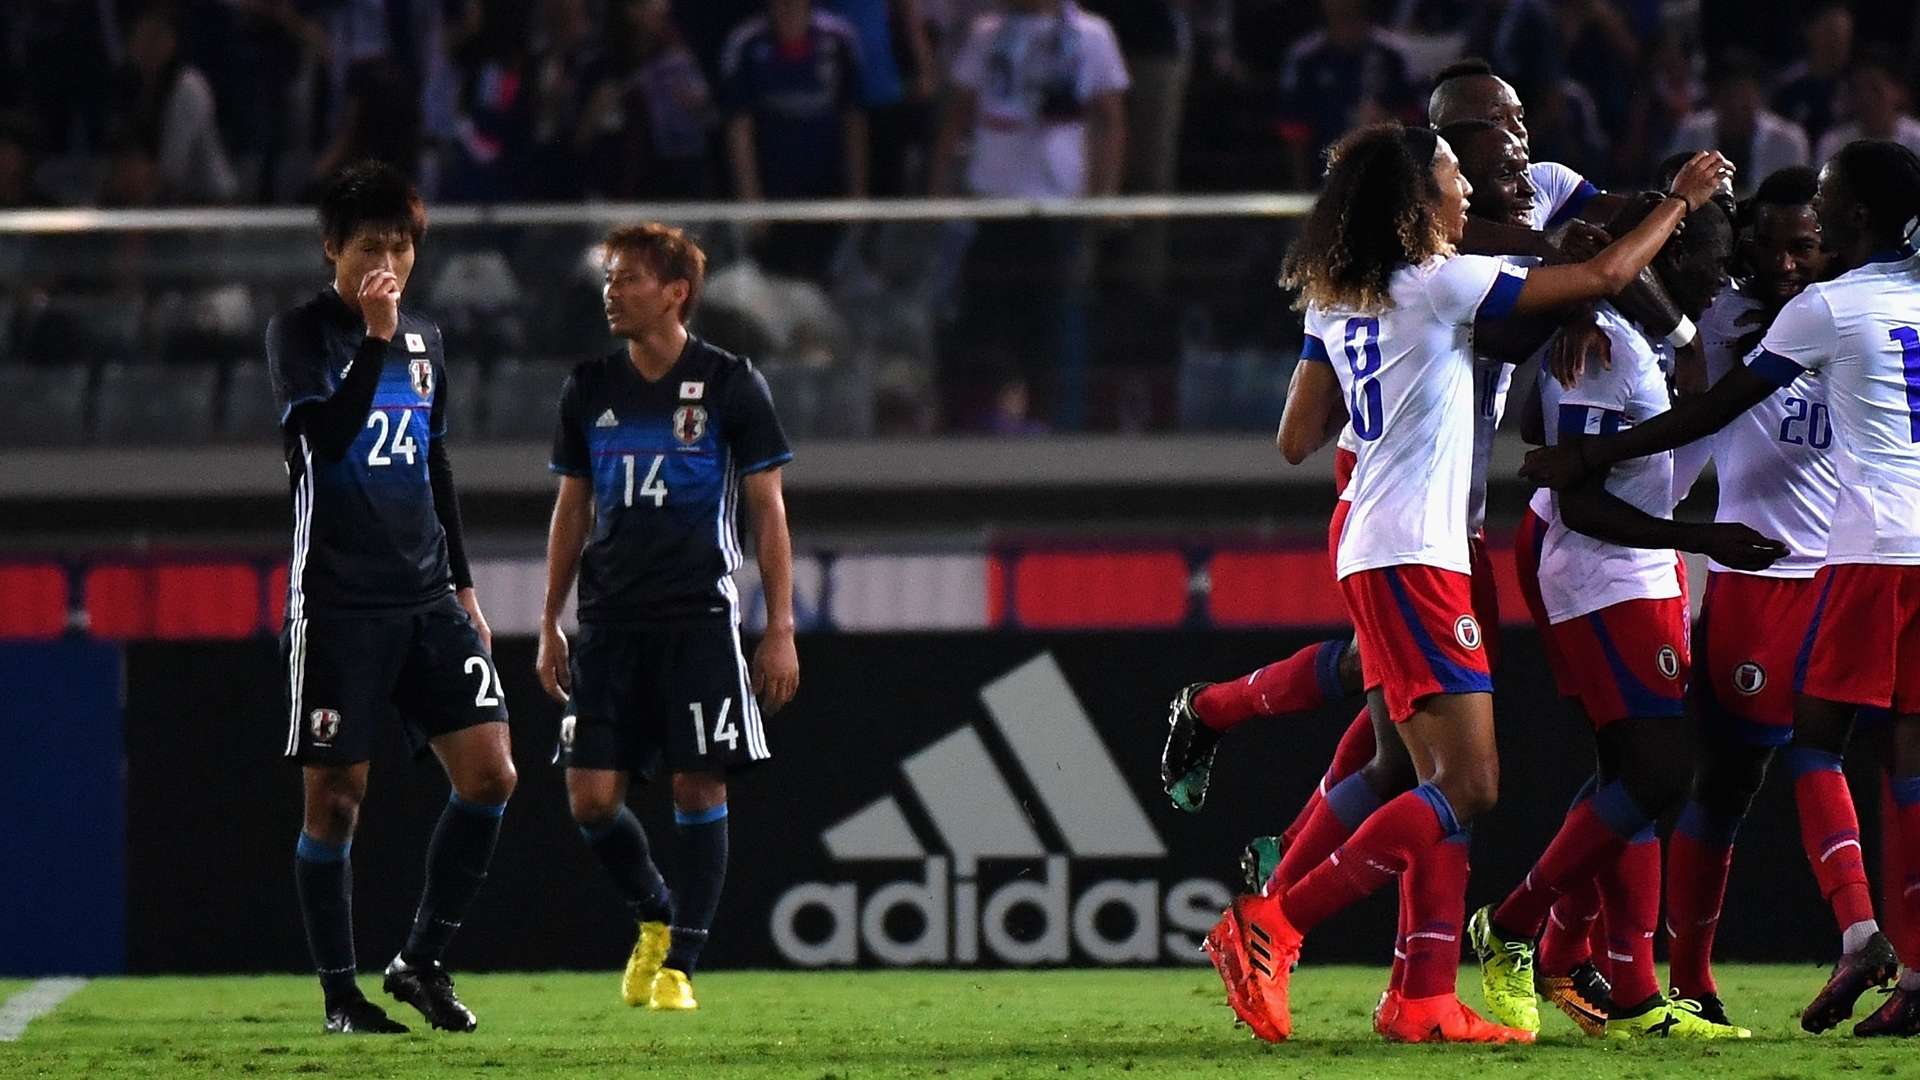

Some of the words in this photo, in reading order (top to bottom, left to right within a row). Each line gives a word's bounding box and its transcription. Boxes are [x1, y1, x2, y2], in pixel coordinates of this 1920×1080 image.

[1343, 316, 1386, 442] 8
[367, 408, 417, 467] 24
[1778, 396, 1833, 450] 20
[621, 454, 669, 508] 14
[688, 696, 739, 756] 14
[770, 854, 1234, 966] adidas
